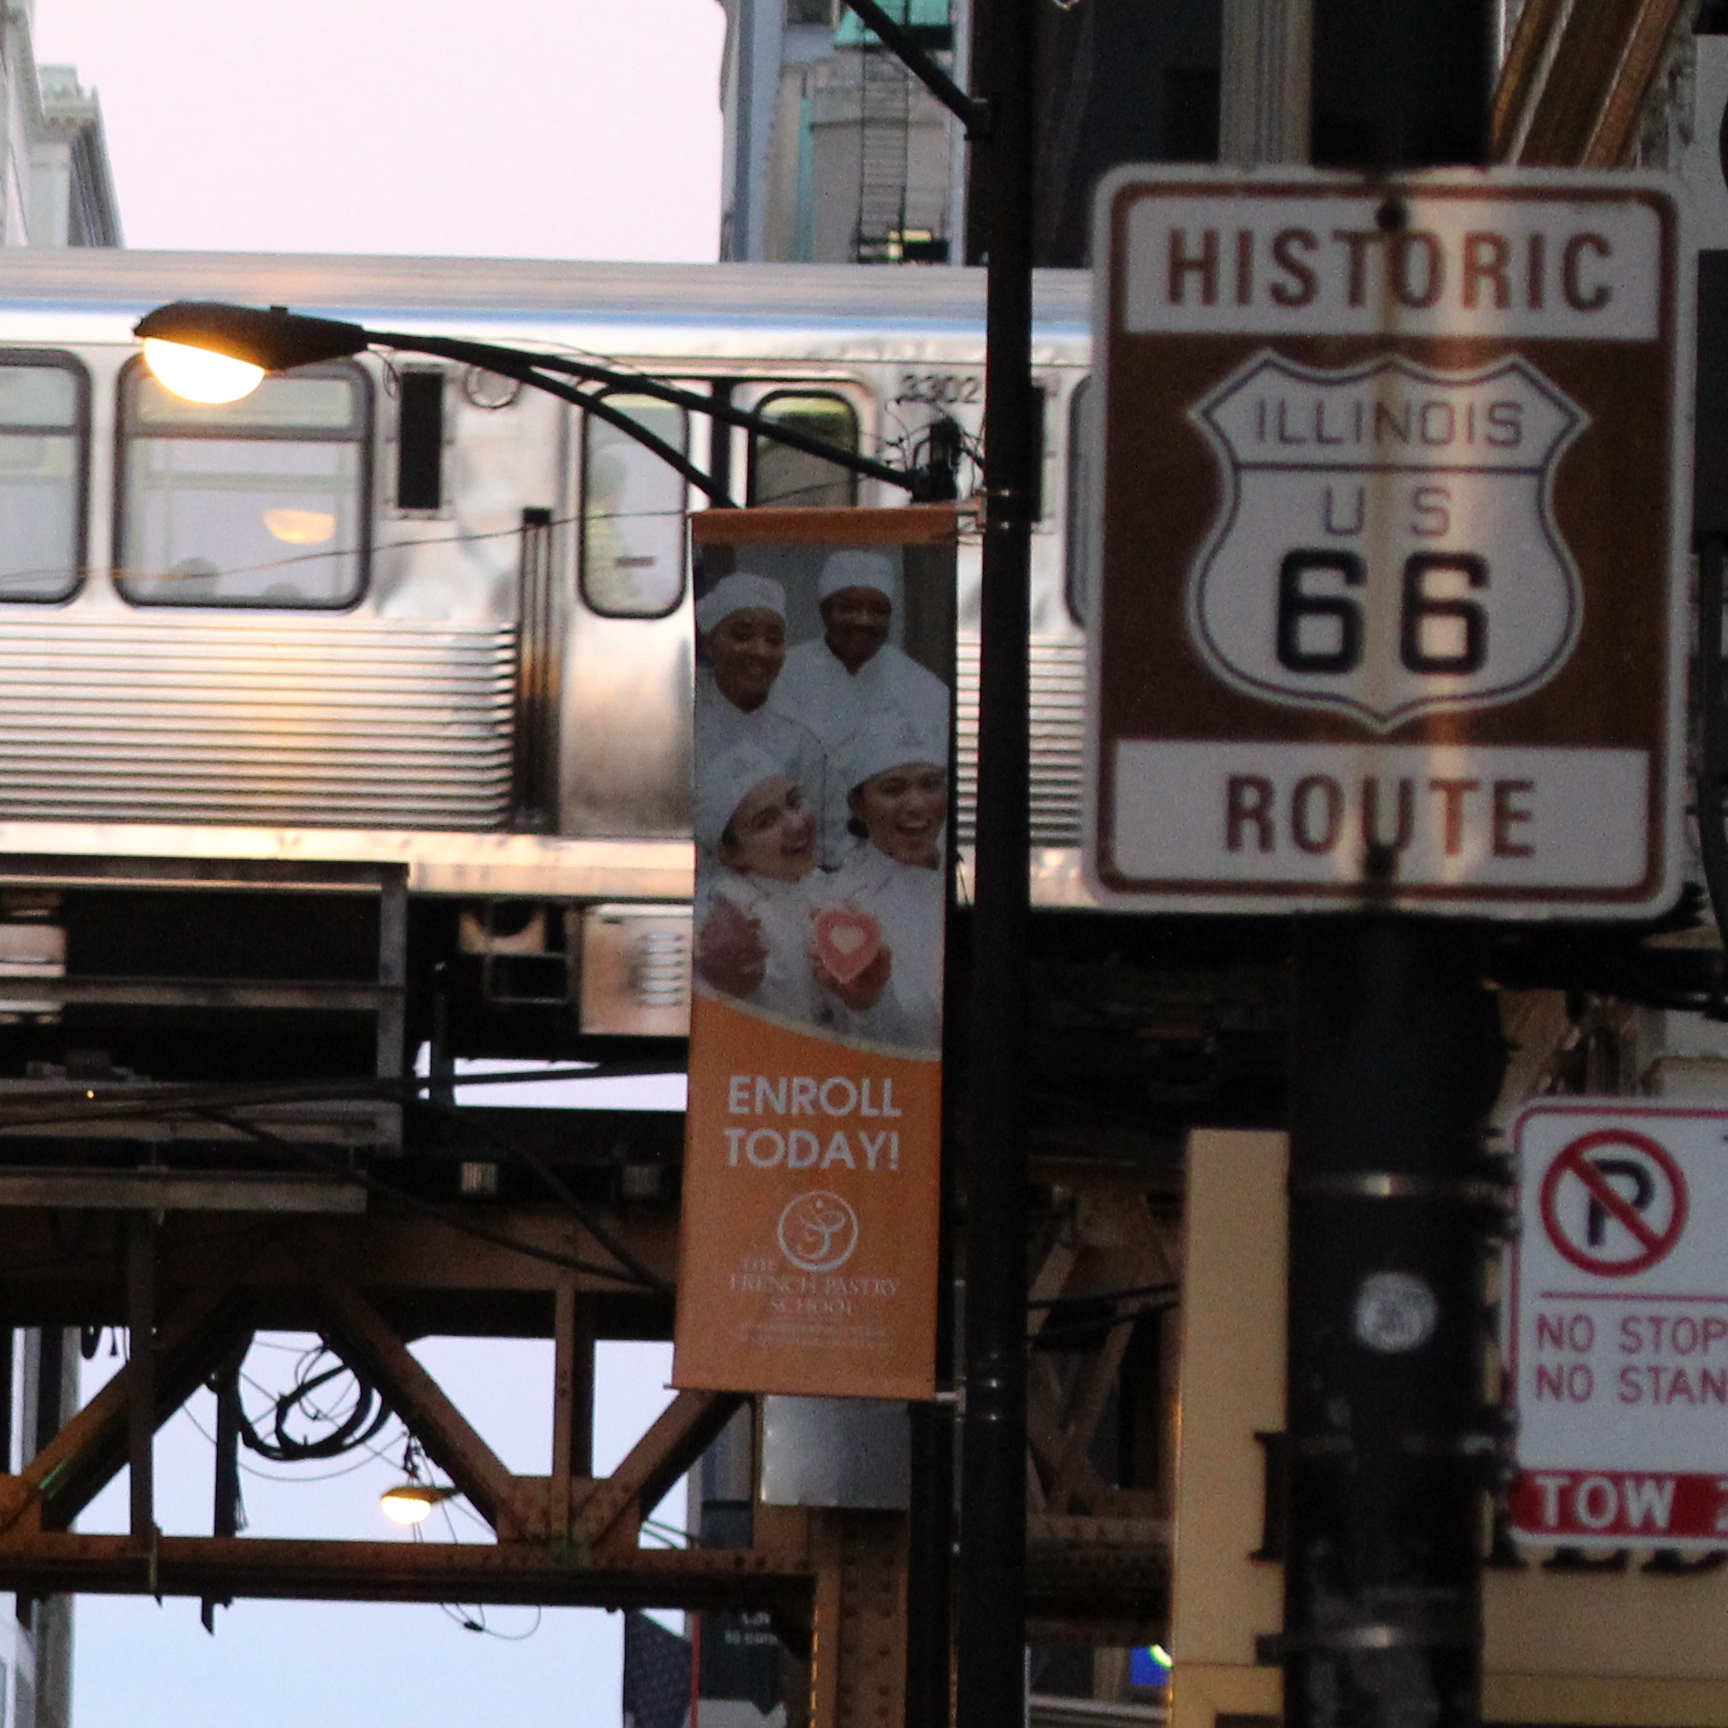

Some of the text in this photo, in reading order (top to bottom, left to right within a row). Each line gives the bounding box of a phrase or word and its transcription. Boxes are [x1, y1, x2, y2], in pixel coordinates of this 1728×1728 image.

[1167, 228, 1612, 312] HISTORIC
[1255, 401, 1523, 446] ILLINOIS
[1274, 548, 1491, 676] 66
[1225, 774, 1536, 858] ROUTE
[728, 1075, 902, 1118] ENROLL
[724, 1128, 899, 1171] TODAY!
[825, 1277, 900, 1297] PASTRY
[1536, 1313, 1594, 1354] NO
[1535, 1362, 1594, 1404] NO
[1535, 1475, 1675, 1530] TOW
